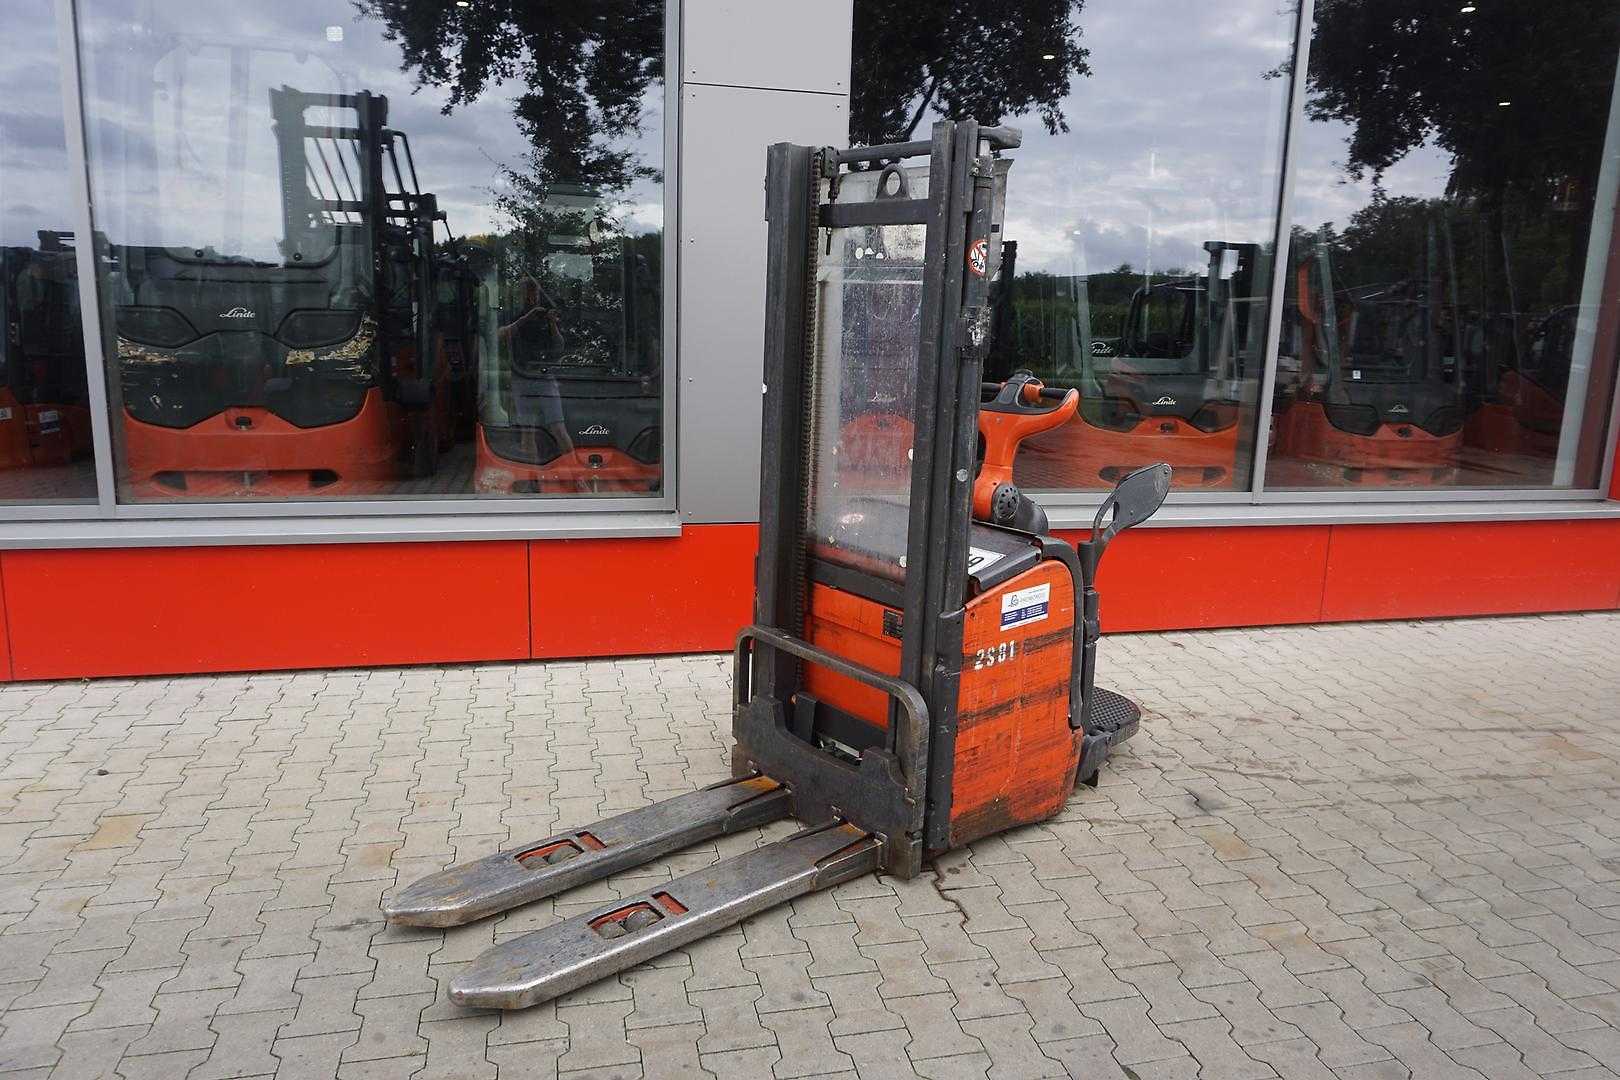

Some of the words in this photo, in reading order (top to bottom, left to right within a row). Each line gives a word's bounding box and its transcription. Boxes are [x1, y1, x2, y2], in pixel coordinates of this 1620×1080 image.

[219, 307, 256, 318] Linde
[1153, 397, 1176, 406] Linde
[579, 424, 610, 435] Linde
